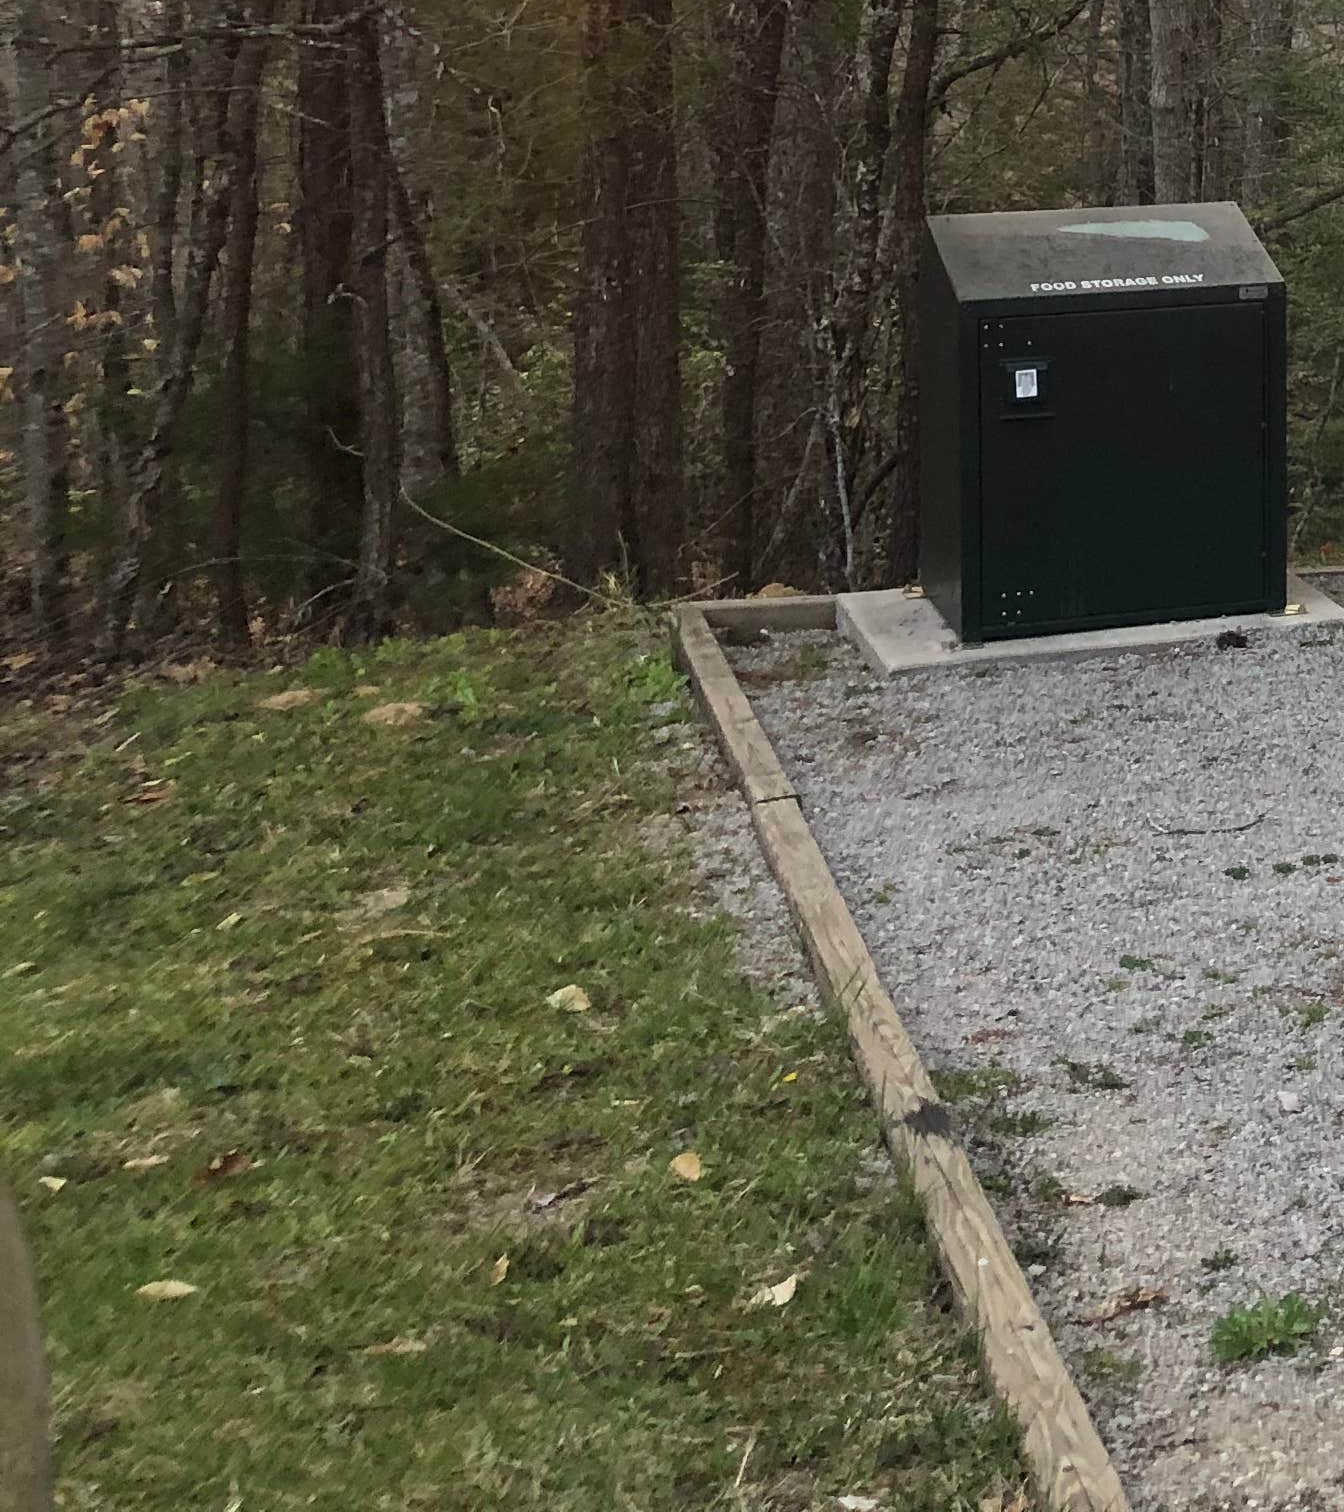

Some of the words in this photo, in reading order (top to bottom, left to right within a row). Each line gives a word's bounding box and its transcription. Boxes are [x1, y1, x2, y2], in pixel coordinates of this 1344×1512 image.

[1030, 280, 1077, 293] FOOD
[1080, 275, 1159, 290] STORAGE
[1162, 273, 1205, 285] ONLY
